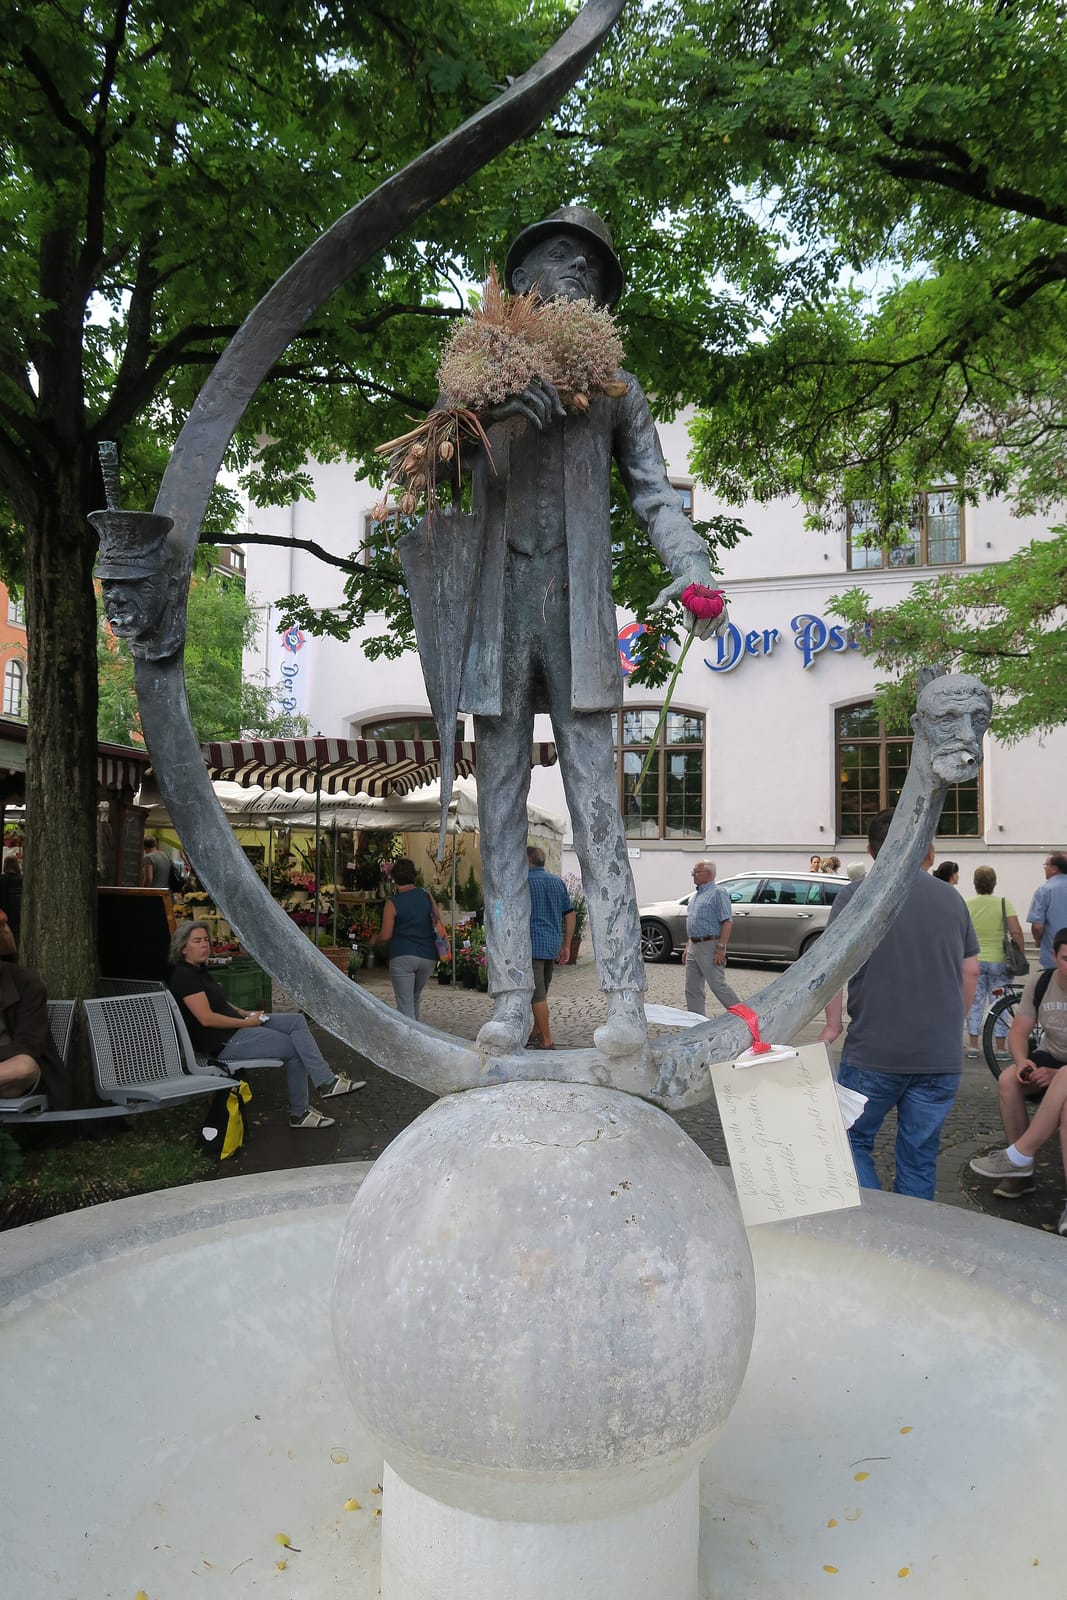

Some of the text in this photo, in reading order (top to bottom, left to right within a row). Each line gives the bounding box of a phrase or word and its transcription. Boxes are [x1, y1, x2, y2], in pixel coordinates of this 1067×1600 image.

[704, 614, 872, 673] Der Ps
[280, 660, 299, 692] Der
[235, 792, 304, 811] Michael
